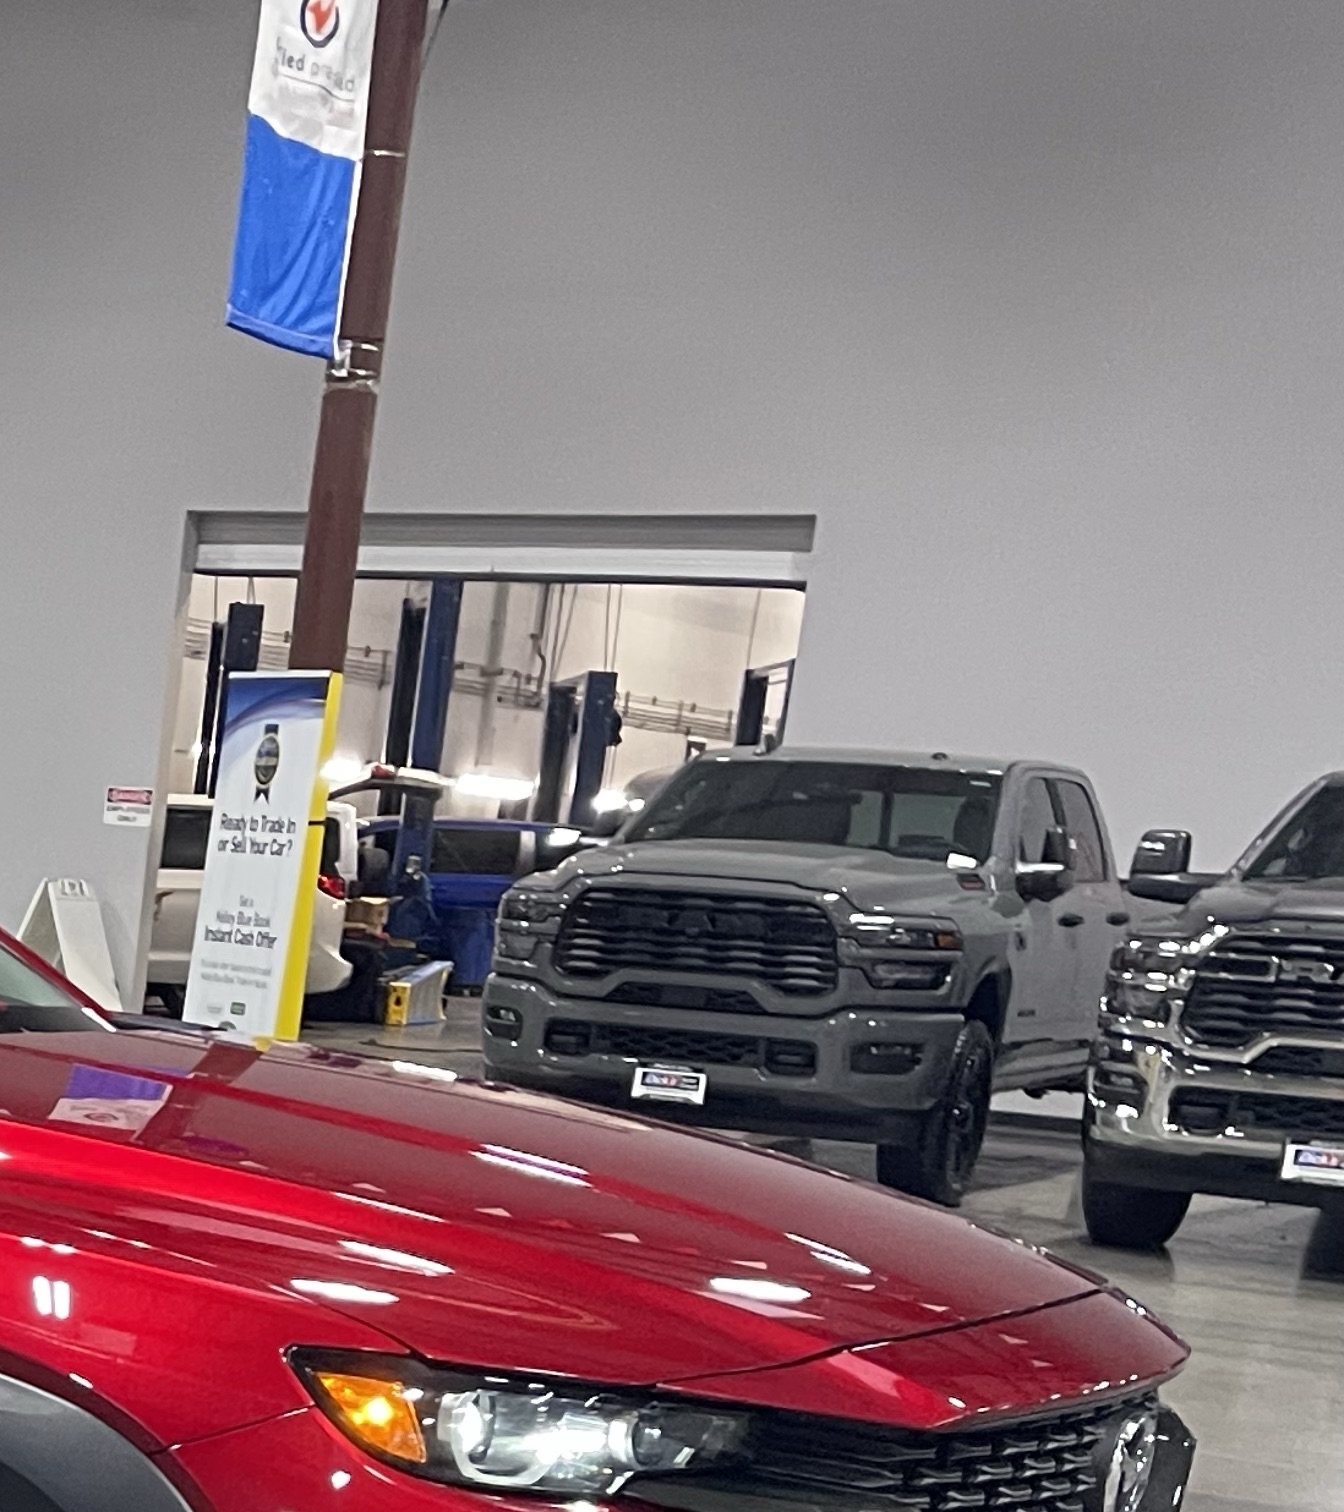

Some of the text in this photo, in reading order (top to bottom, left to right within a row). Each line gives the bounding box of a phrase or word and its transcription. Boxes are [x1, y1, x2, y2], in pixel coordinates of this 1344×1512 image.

[220, 812, 246, 835] Ready
[249, 815, 259, 832] to
[261, 814, 285, 833] Trade
[217, 835, 293, 856] or Sell Your Car?
[234, 928, 255, 946] Cash
